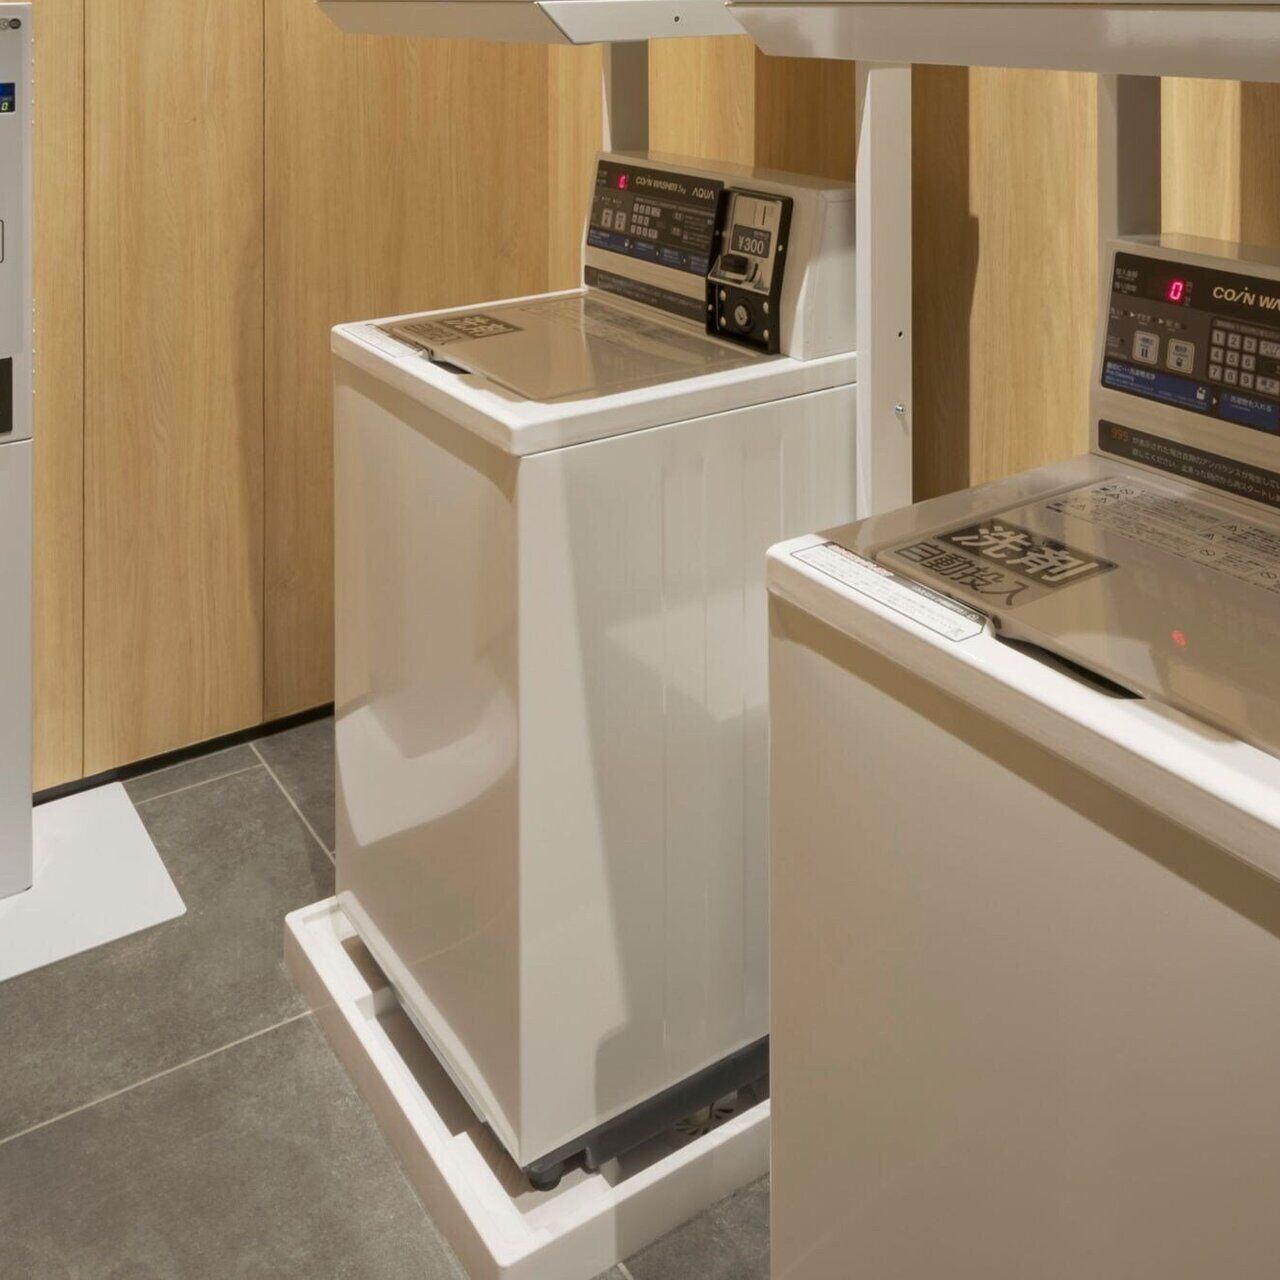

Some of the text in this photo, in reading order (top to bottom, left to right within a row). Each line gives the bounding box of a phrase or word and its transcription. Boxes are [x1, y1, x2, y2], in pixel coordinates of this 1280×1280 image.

[1, 102, 9, 111] 0
[692, 187, 715, 200] AQUA
[738, 232, 765, 255] ¥300
[1170, 281, 1183, 301] 0
[1212, 286, 1256, 306] COIN
[1231, 336, 1237, 346] 2
[1247, 339, 1253, 349] 3
[1229, 354, 1236, 364] 5
[1245, 357, 1251, 367] 6
[1244, 375, 1250, 384] 9
[951, 525, 1099, 582] 洗剤
[894, 541, 1029, 606] 自動投入
